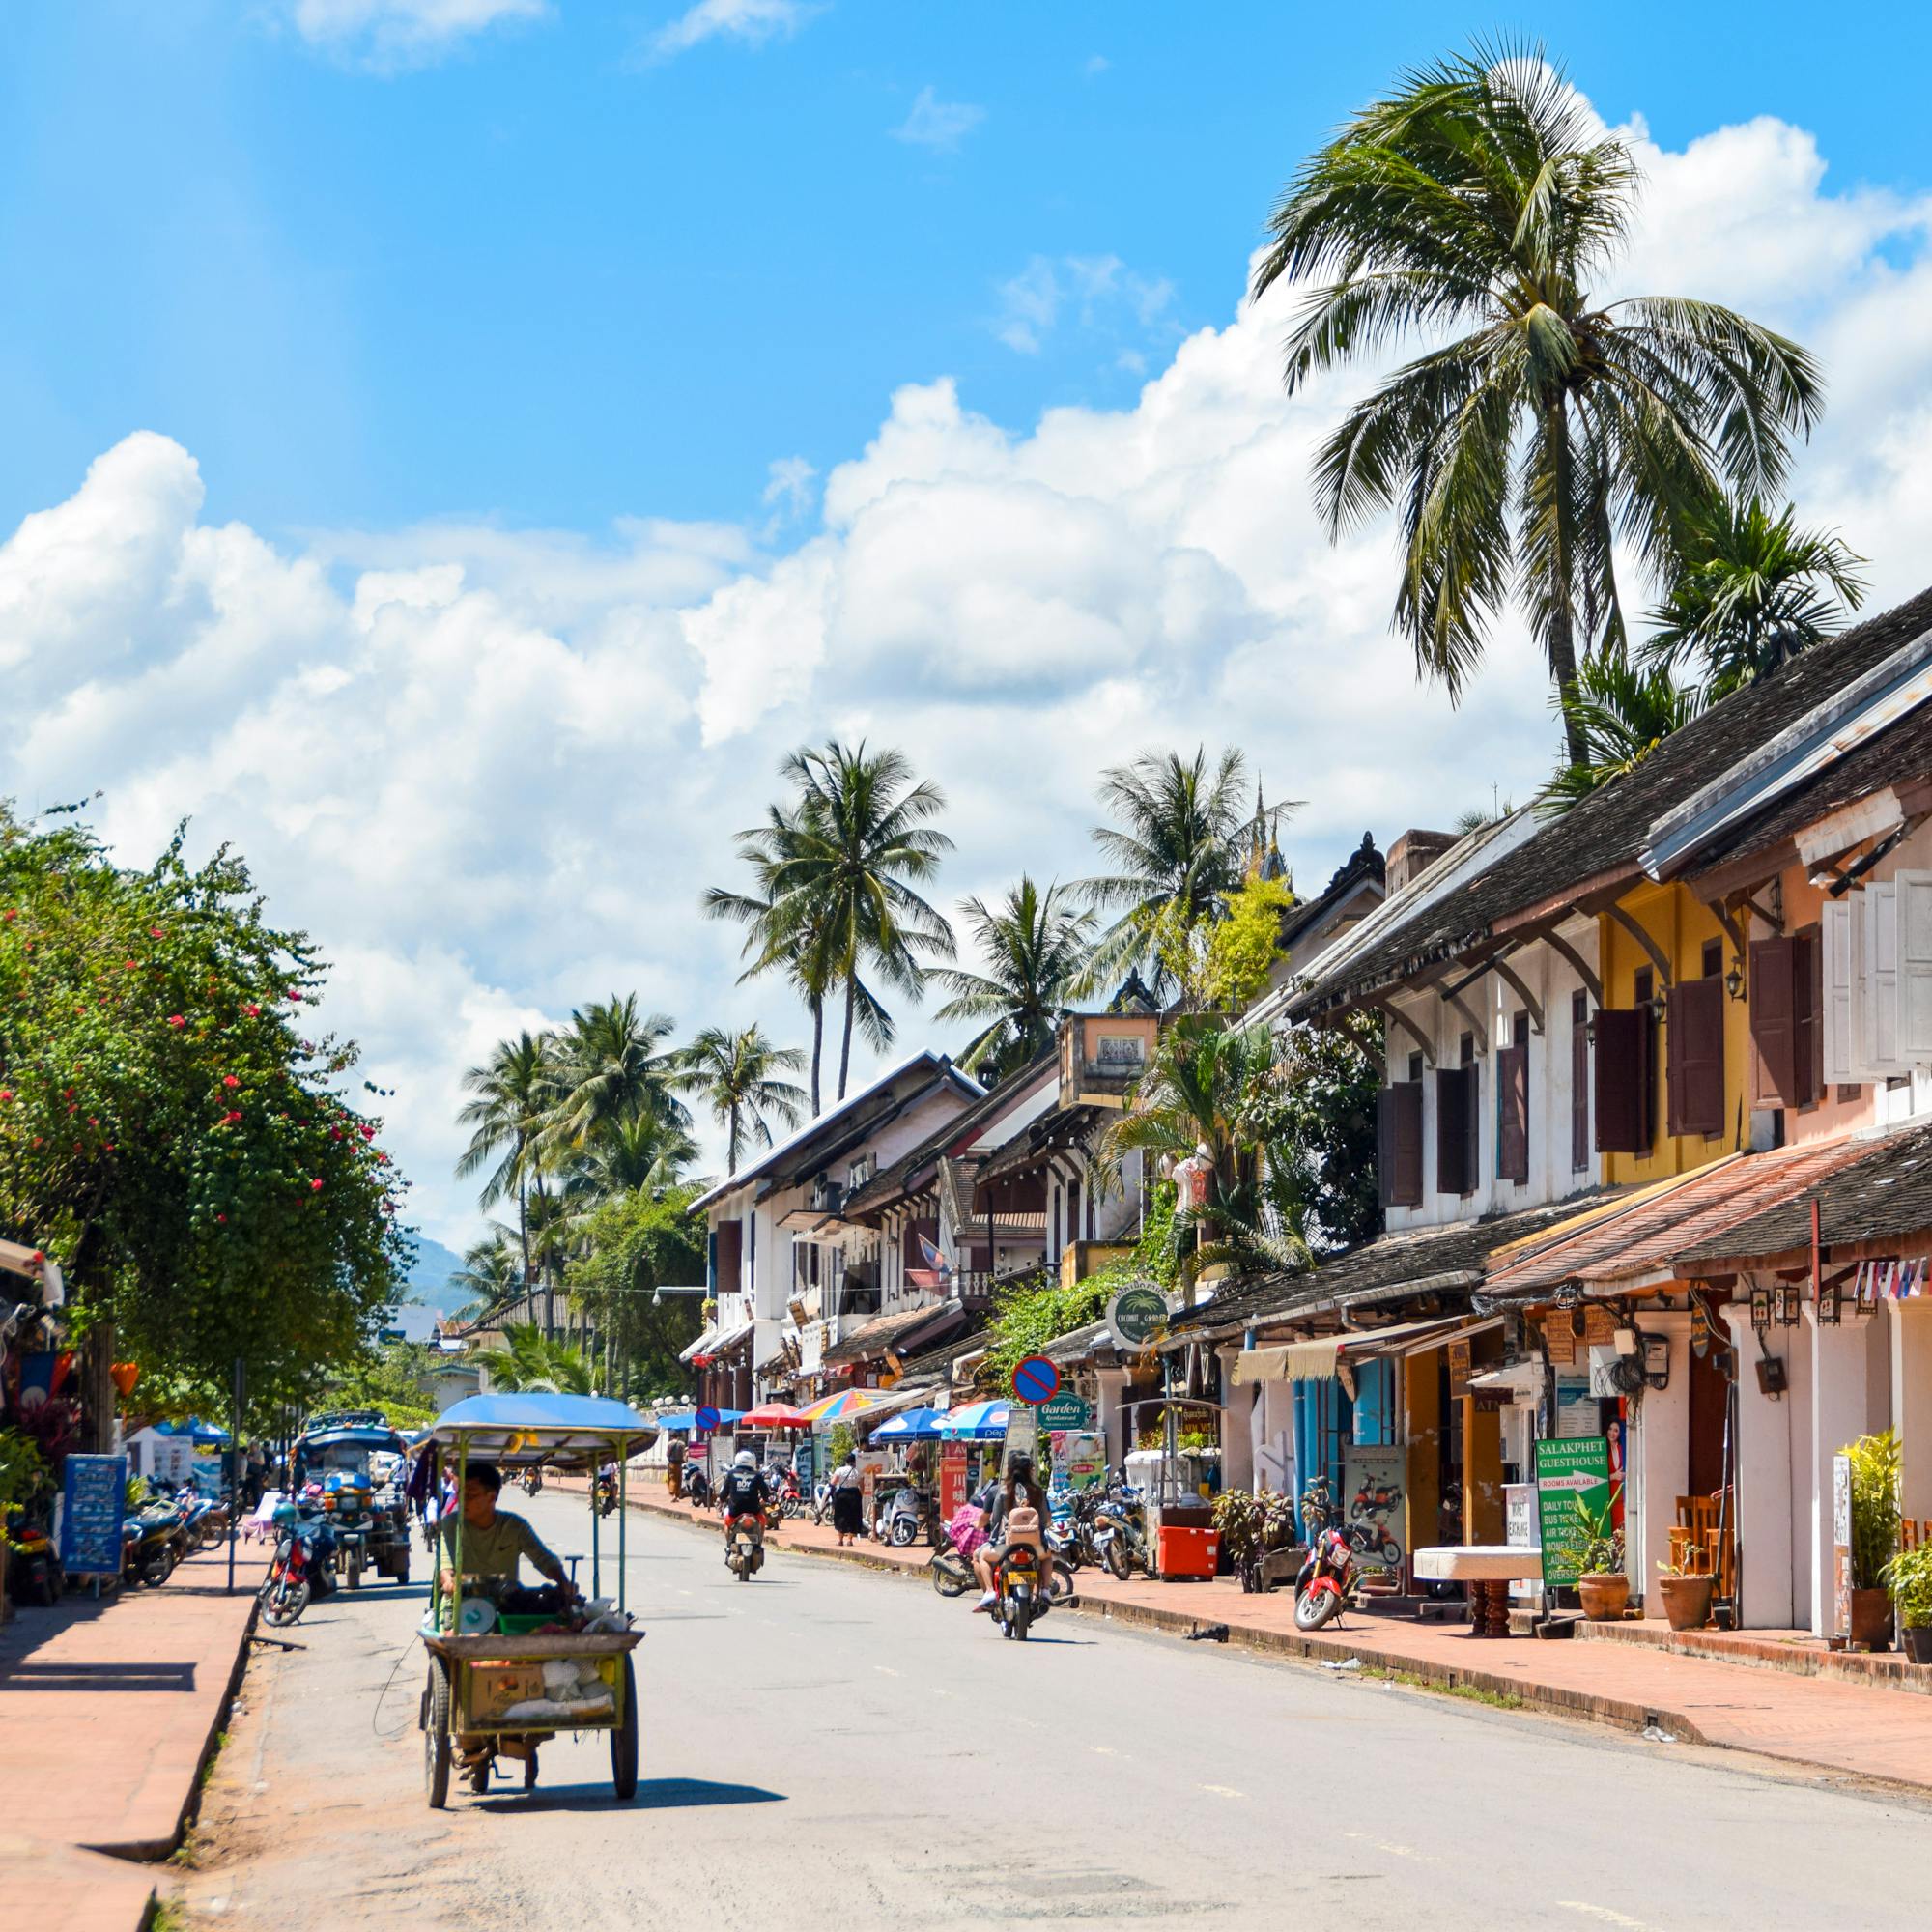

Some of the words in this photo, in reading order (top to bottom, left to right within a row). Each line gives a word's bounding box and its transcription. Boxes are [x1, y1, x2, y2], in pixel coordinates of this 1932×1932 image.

[1041, 1402, 1080, 1414] Garden
[985, 1430, 1005, 1438] pep
[1539, 1441, 1604, 1455] SALAKPHET
[1539, 1456, 1605, 1468] GUESTHOUSE
[1543, 1501, 1562, 1512] DAILY
[1563, 1500, 1578, 1510] TOU
[1544, 1515, 1557, 1524] BUS
[1509, 1521, 1528, 1538] EXCHANGE
[1546, 1528, 1557, 1538] AIR
[1546, 1541, 1568, 1551] MONEY
